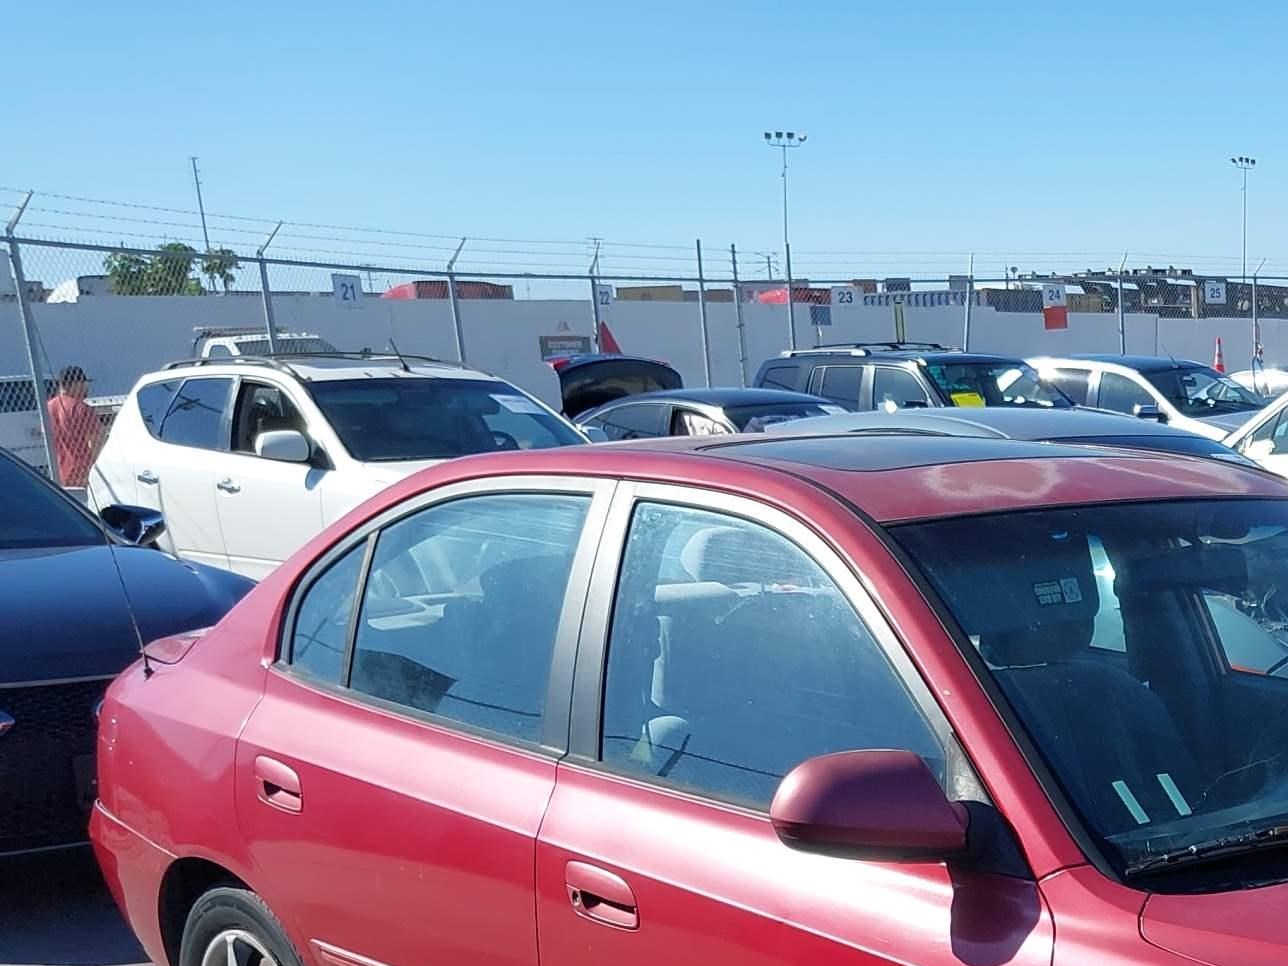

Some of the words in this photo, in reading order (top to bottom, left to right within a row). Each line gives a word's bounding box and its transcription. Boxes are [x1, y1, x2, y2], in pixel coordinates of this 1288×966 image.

[340, 282, 356, 301] 21
[599, 290, 611, 305] 22
[837, 290, 854, 304] 23
[1047, 289, 1061, 301] 24
[1209, 287, 1222, 299] 25
